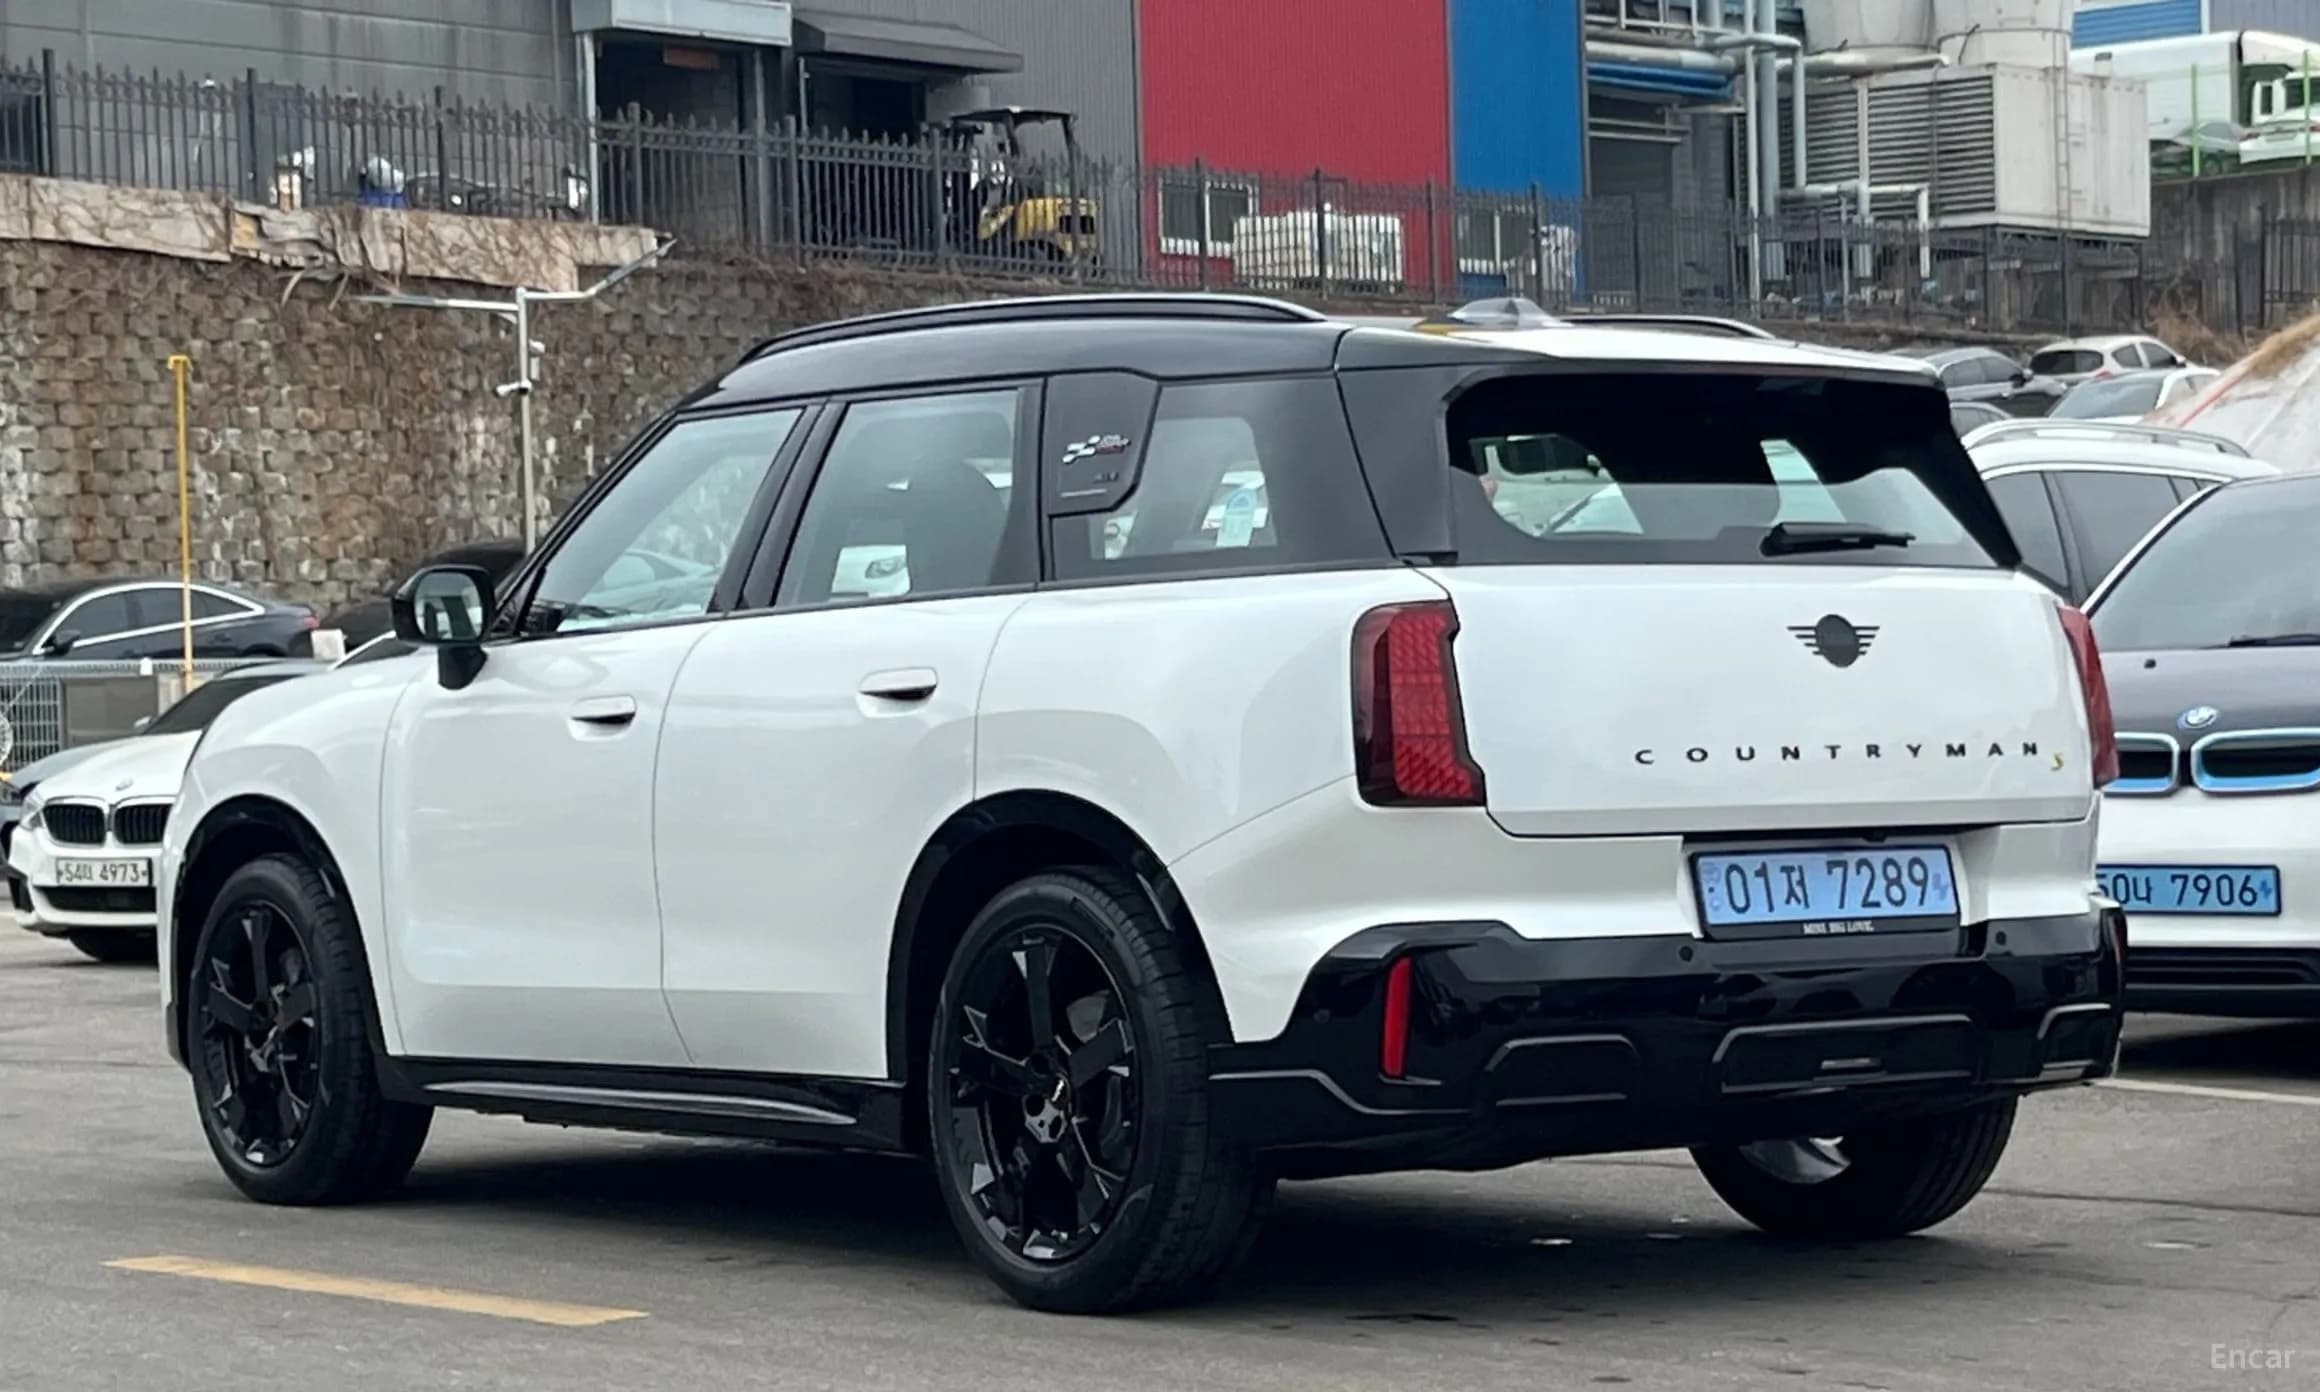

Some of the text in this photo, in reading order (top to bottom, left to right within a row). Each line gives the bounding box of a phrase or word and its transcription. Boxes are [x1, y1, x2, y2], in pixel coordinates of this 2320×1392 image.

[1634, 742, 2039, 765] COUNTRYMAN
[99, 862, 140, 883] 4973
[1725, 857, 1929, 915] 01저 7289
[2170, 873, 2258, 907] 7906
